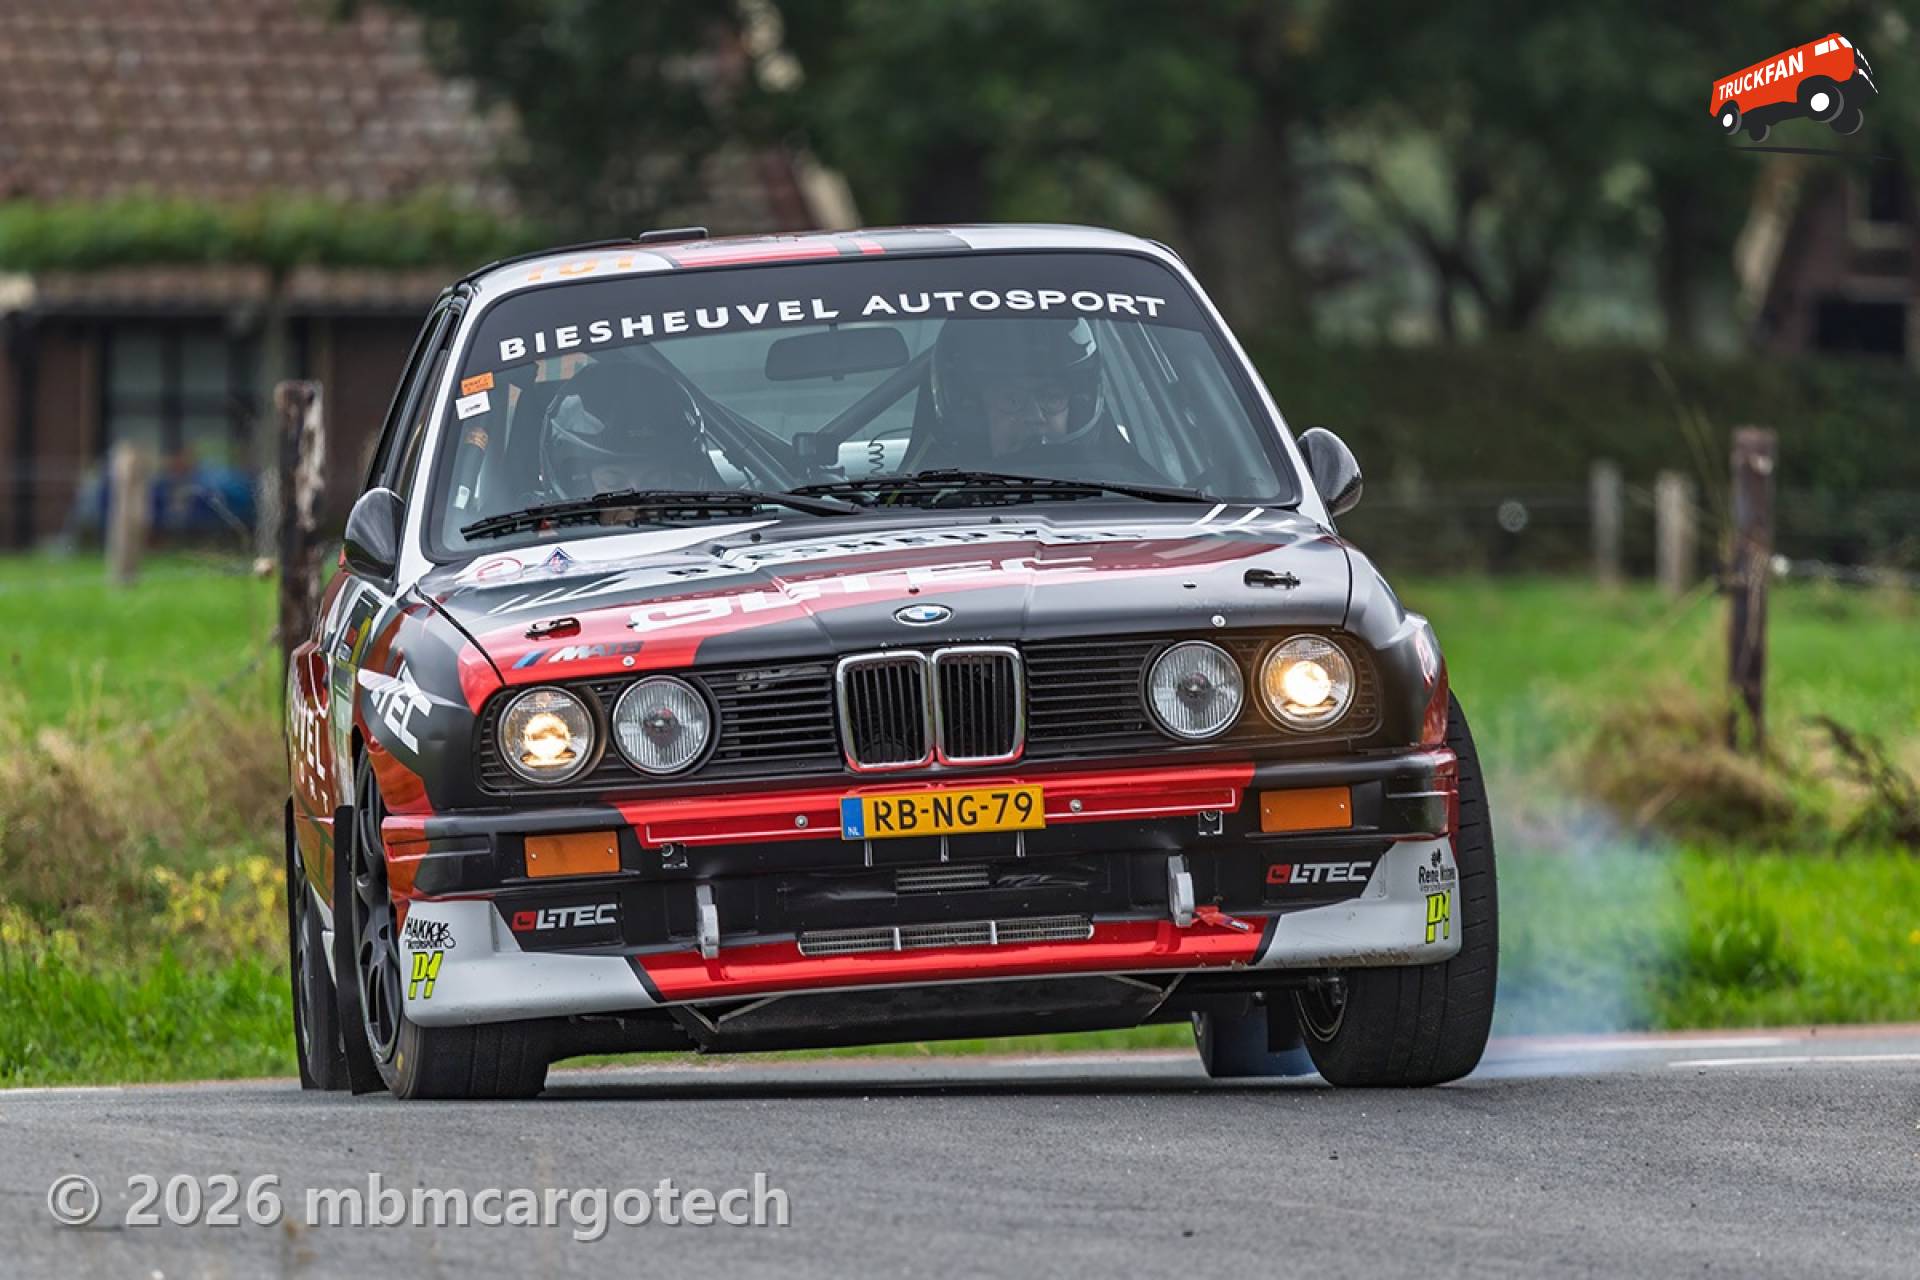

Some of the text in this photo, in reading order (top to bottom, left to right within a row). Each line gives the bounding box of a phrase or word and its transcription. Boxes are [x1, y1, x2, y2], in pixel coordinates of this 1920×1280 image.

[499, 290, 1166, 362] BIESHEUVEL AUTOSPORT
[847, 826, 861, 837] NL
[872, 791, 1034, 832] RB-NG-79
